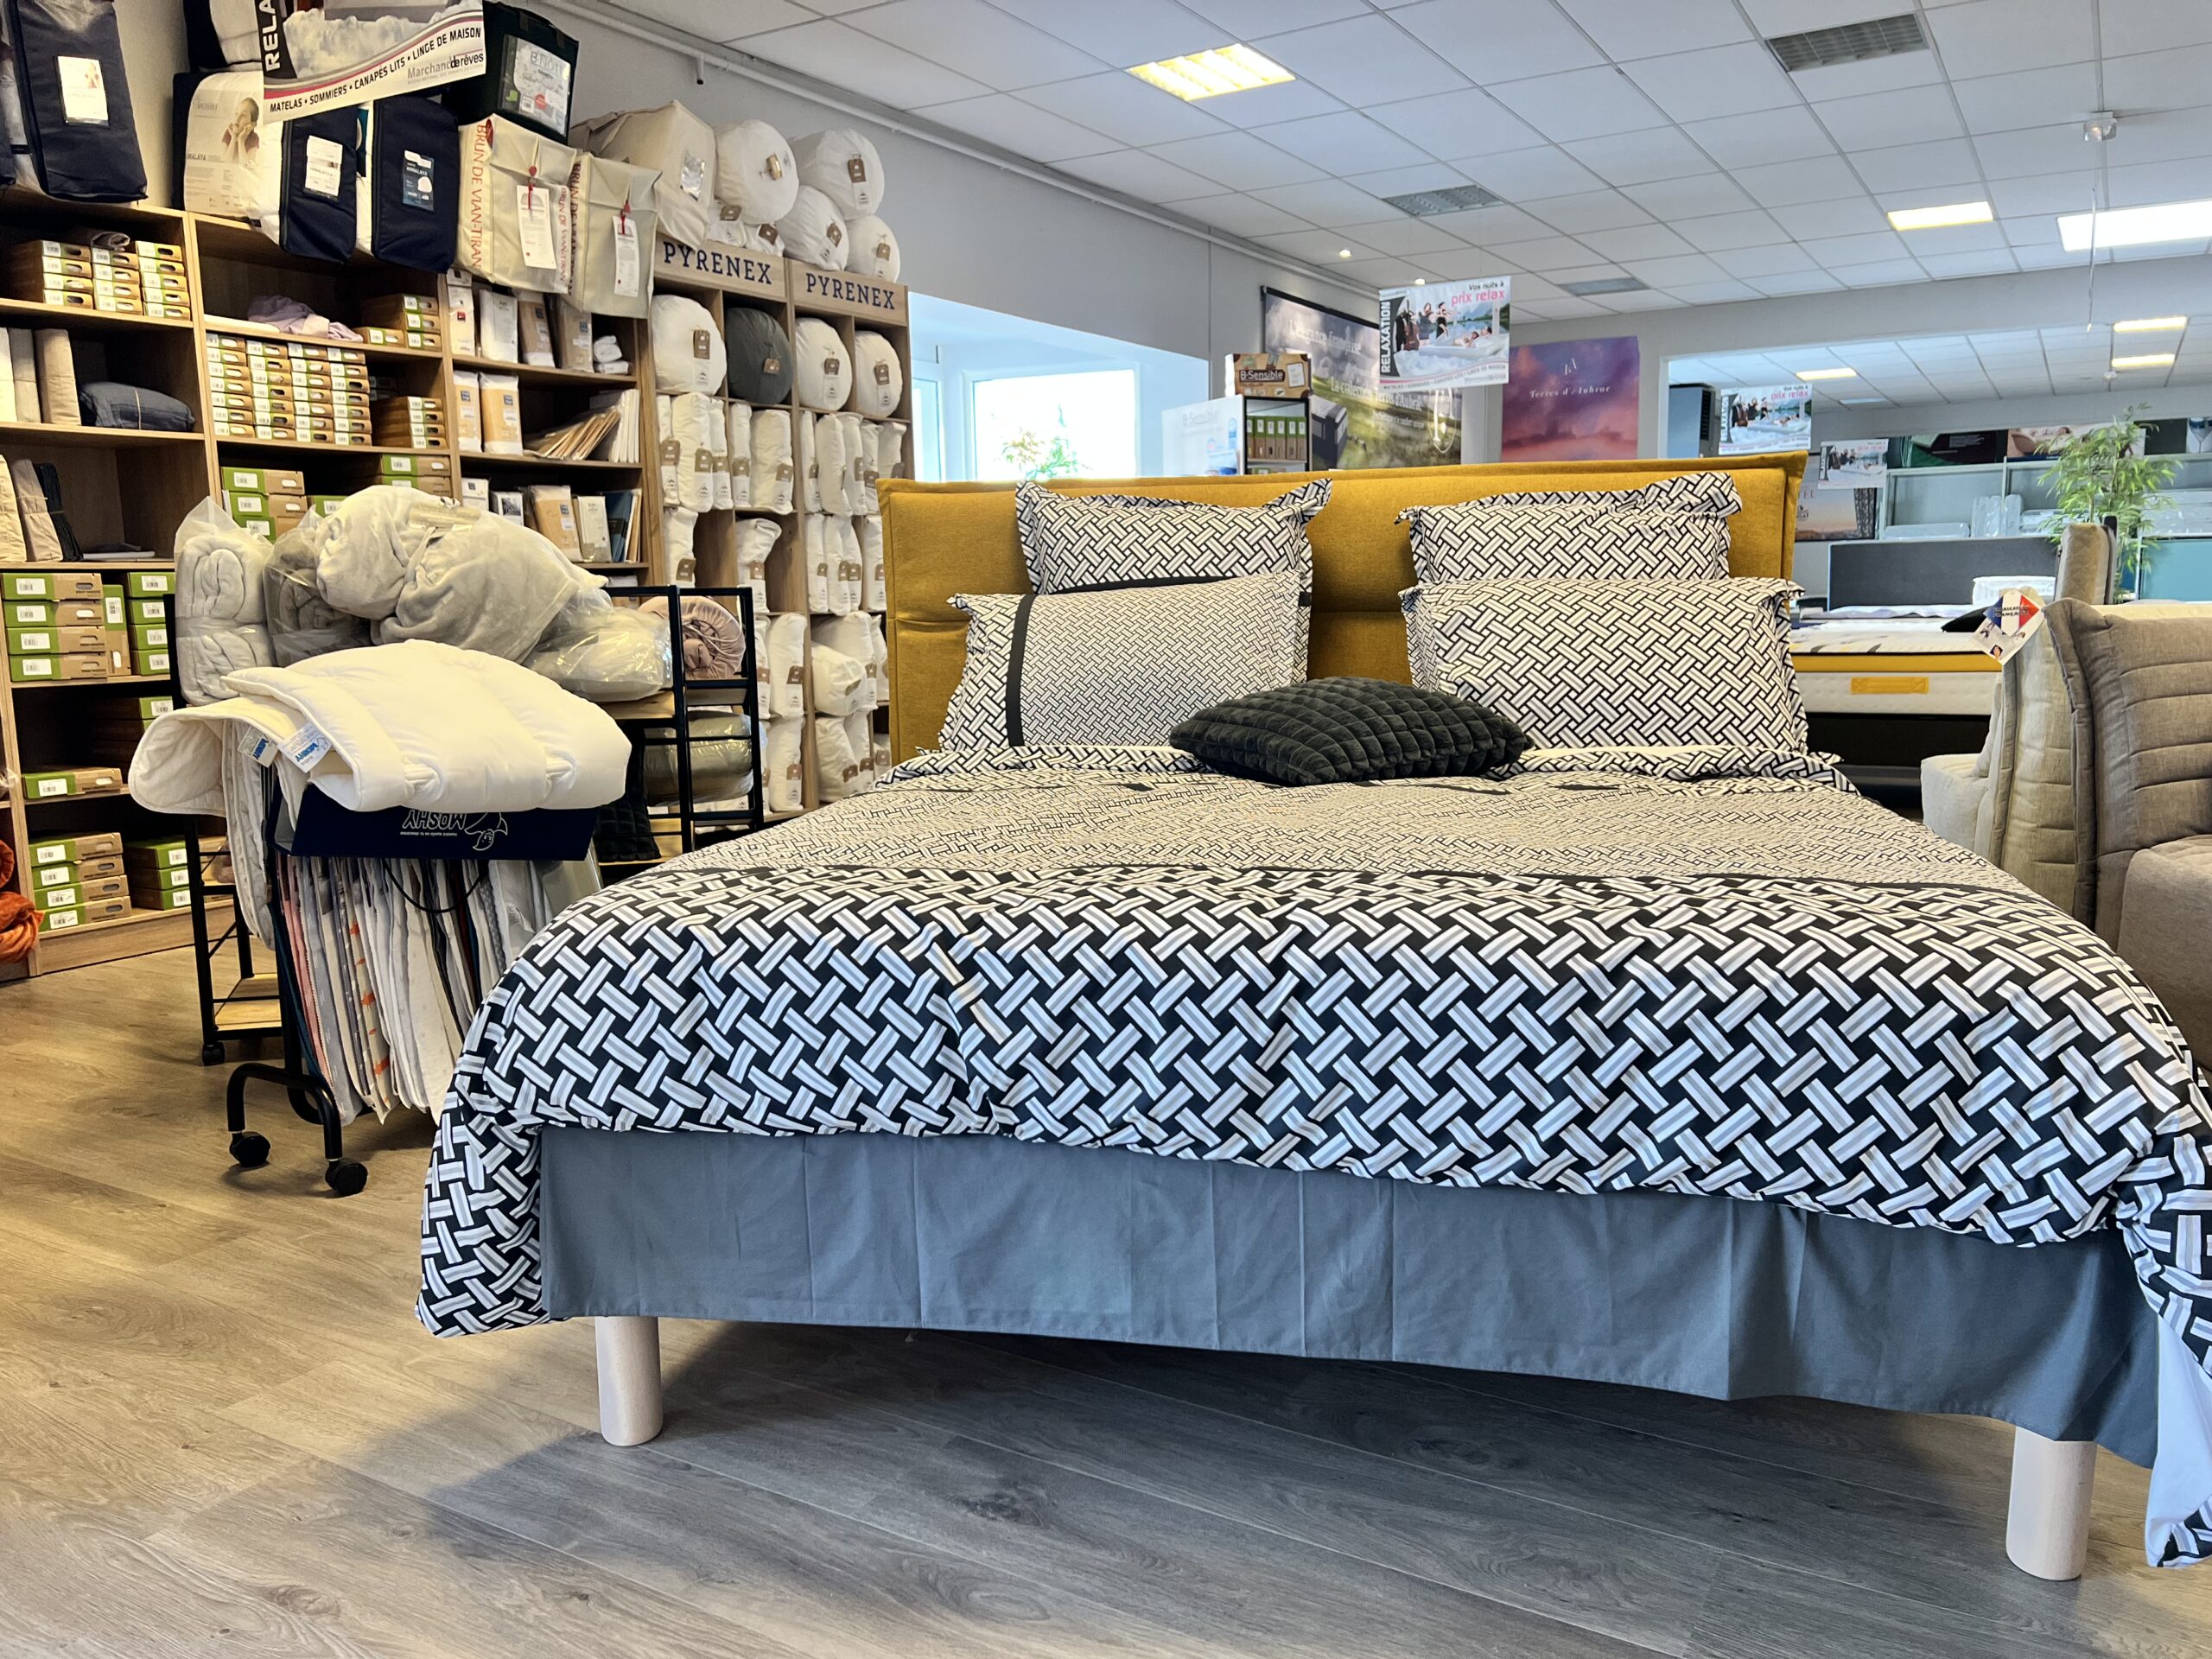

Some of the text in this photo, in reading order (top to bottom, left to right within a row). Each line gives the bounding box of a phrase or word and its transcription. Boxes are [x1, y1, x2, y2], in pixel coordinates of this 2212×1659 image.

[270, 99, 302, 112] MATELAS
[309, 86, 347, 105] SOMMIERS
[390, 59, 405, 73] LITS
[412, 40, 435, 60] LINGE
[436, 34, 448, 48] DE
[449, 27, 481, 42] MAISON
[474, 124, 486, 164] BRUN
[472, 166, 484, 186] DE
[663, 241, 772, 285] PYRENEX
[805, 272, 895, 310] PYRENEX
[1451, 289, 1505, 307] prix relax
[1381, 301, 1391, 372] RELAXATION
[402, 810, 467, 830] MOSHY
